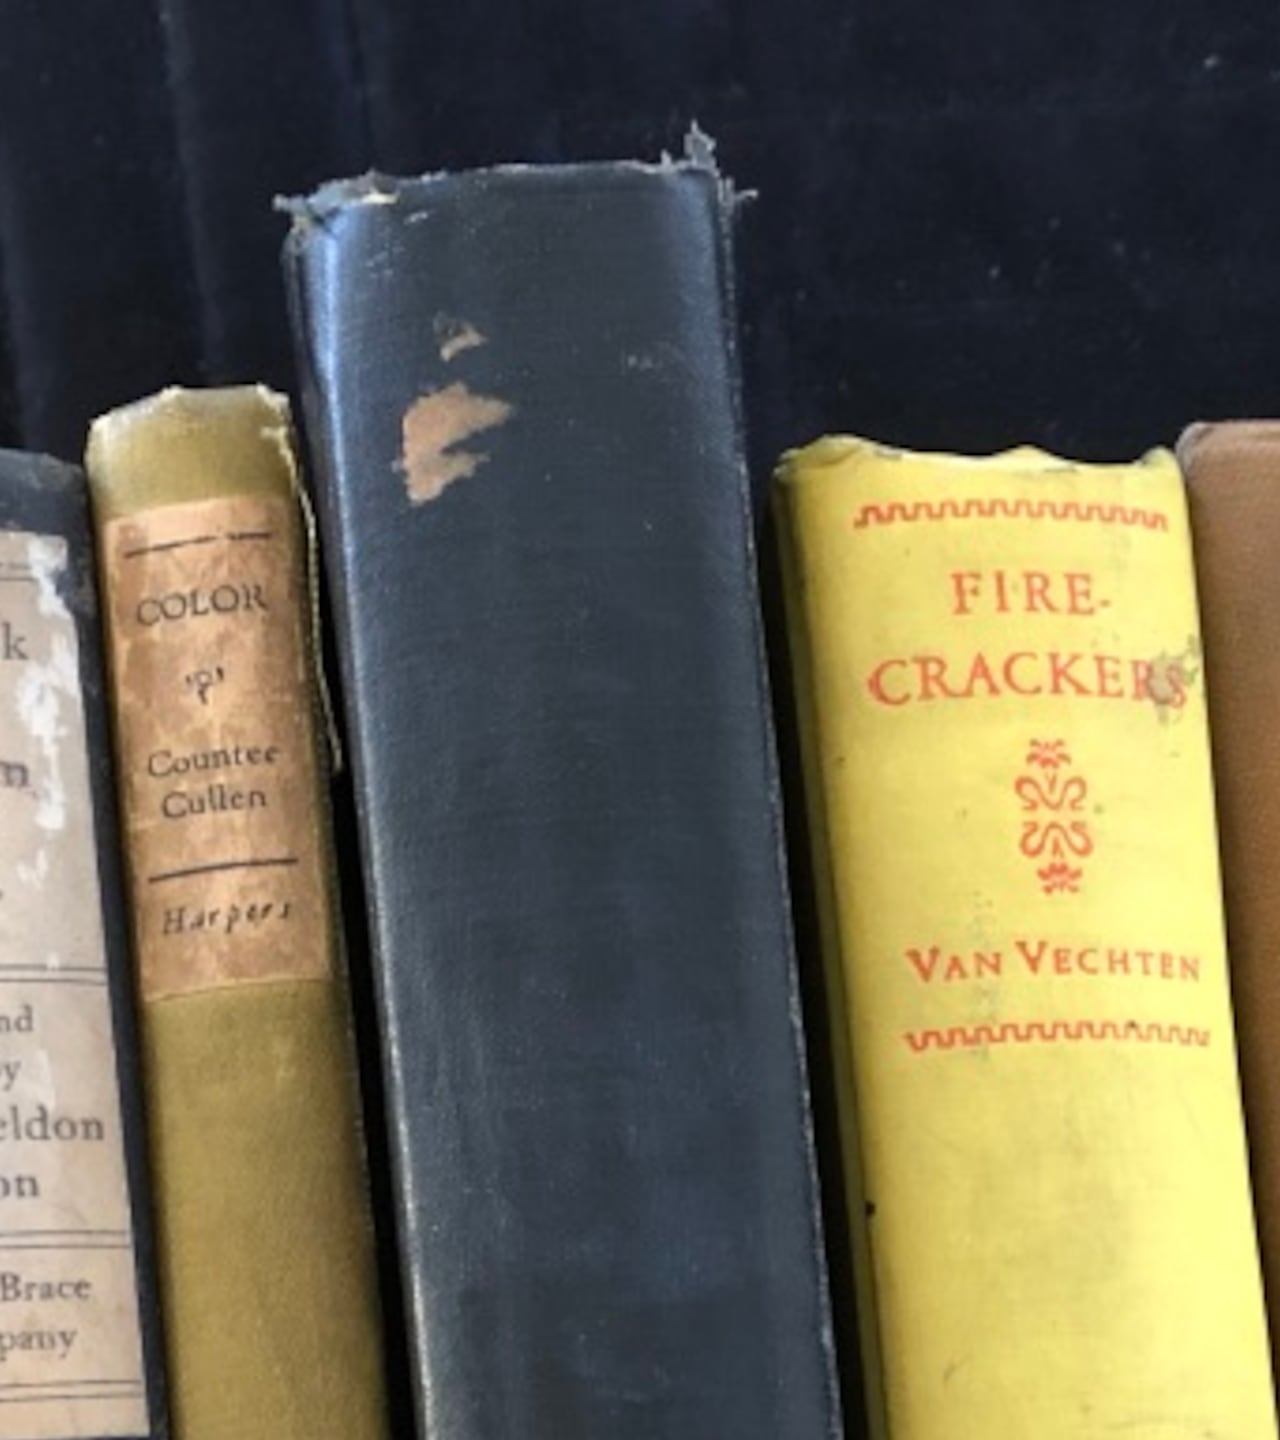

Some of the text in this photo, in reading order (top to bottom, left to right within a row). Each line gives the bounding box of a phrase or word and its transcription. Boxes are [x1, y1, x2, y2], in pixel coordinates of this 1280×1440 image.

[136, 583, 269, 627] COLOR
[951, 570, 1110, 616] FIRE-
[867, 652, 1187, 708] CRACKERS
[147, 745, 280, 777] Countee
[162, 789, 267, 820] Cullen
[163, 902, 289, 935] Harpers
